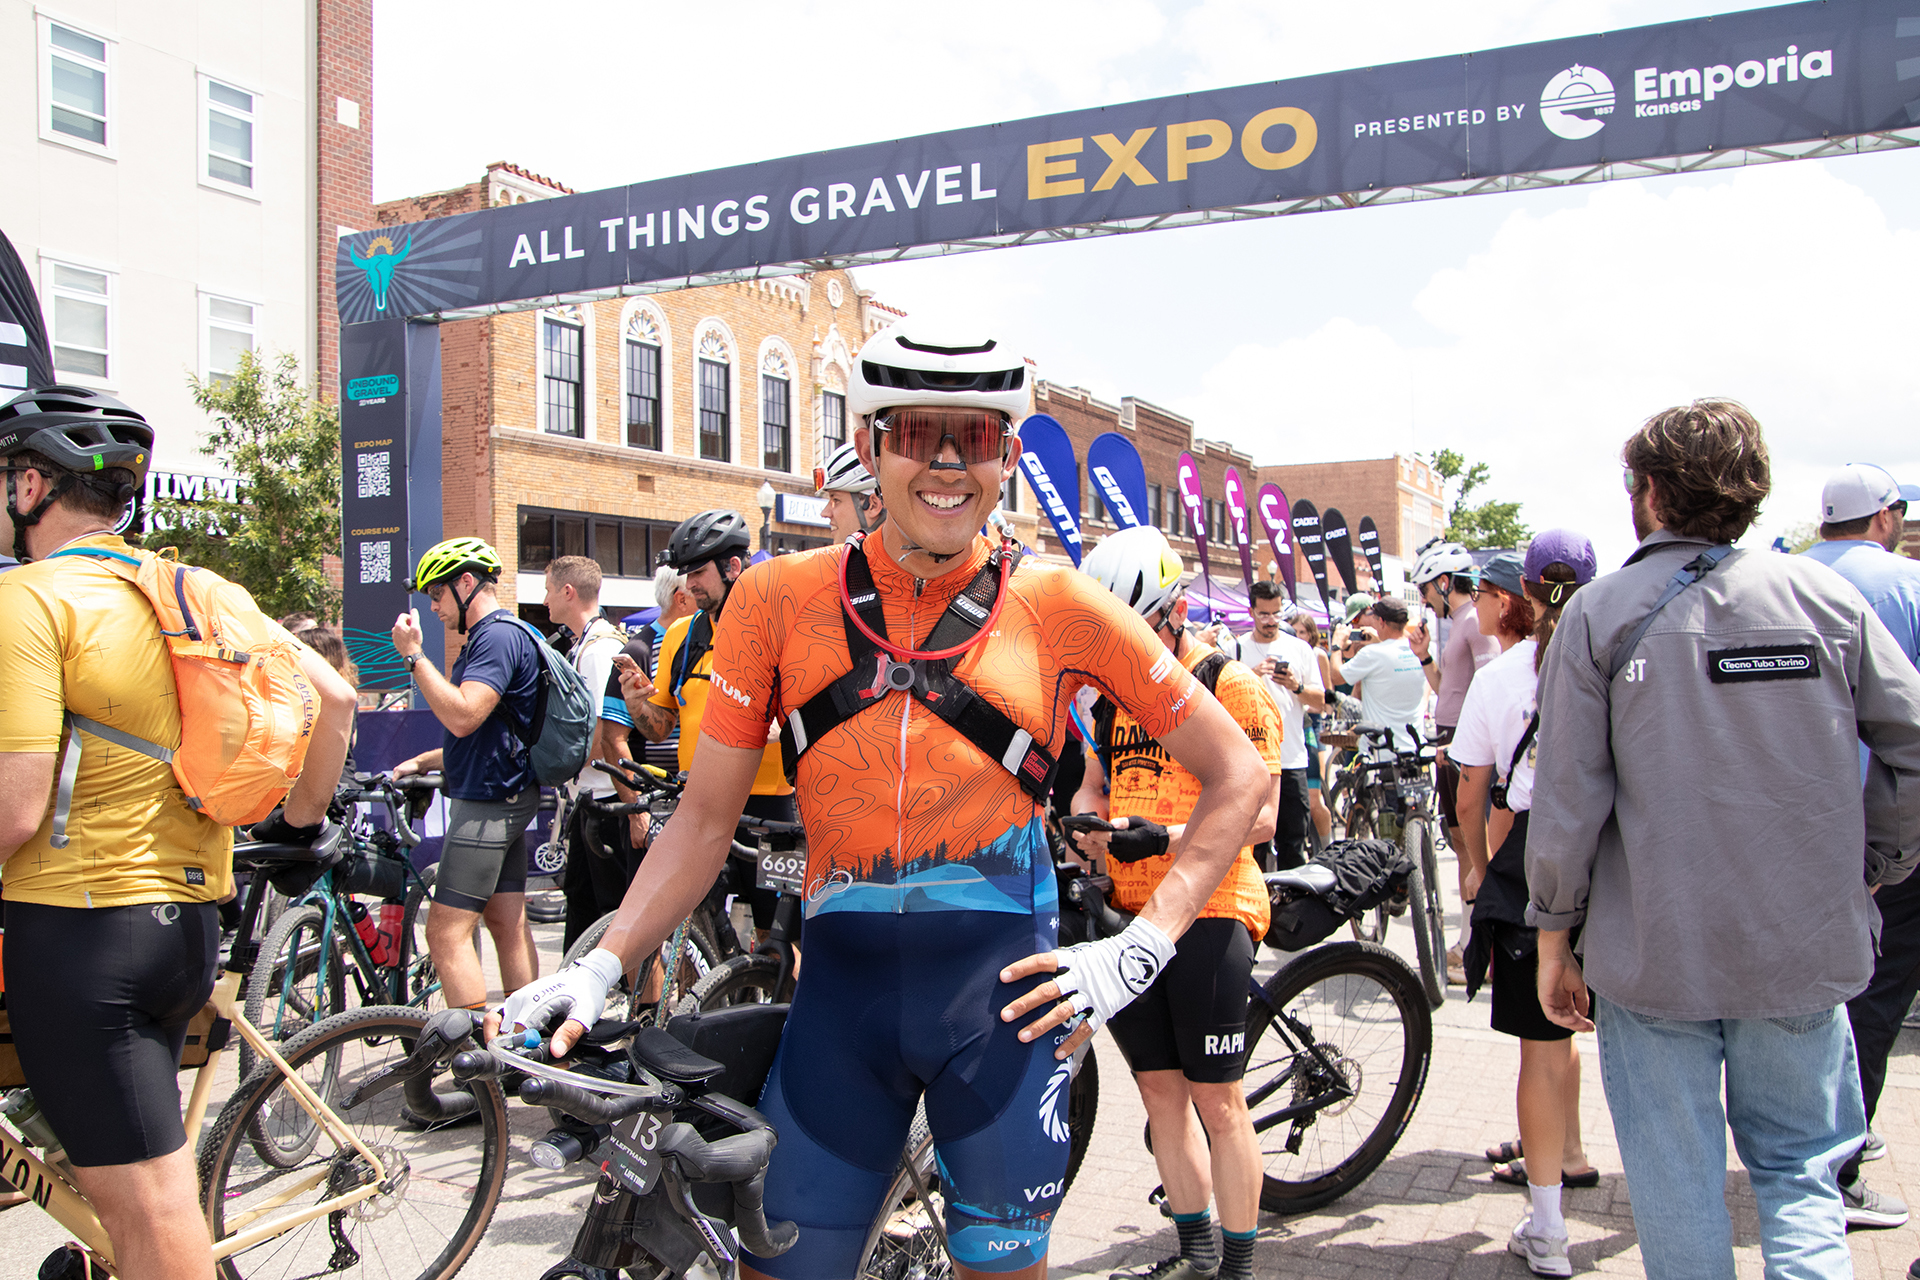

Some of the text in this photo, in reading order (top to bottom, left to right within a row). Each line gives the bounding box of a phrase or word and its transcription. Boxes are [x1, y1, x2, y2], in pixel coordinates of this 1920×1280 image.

[1634, 44, 1832, 102] Emporia
[1593, 105, 1615, 116] 1857
[1635, 99, 1702, 118] Kansas
[1354, 103, 1526, 138] PRESENTED BY
[508, 106, 1319, 268] ALL THINGS GRAVEL EXPO
[348, 376, 398, 390] UNBOUND
[353, 386, 392, 398] GRAVEL
[354, 438, 393, 449] EXPO MAP
[1020, 451, 1082, 545] GIANT
[1292, 516, 1319, 528] CADEX
[350, 526, 400, 536] COURSE MAP
[1325, 527, 1347, 541] CADEX
[1625, 658, 1647, 683] 3T
[1723, 657, 1805, 670] Tecno Tubo Torino
[292, 674, 314, 738] CAMELBAK
[1170, 697, 1186, 713] NO
[187, 871, 203, 881] GORE
[764, 879, 777, 888] XL
[614, 1139, 648, 1167] LEFTHAND
[987, 1239, 1020, 1252] NO
